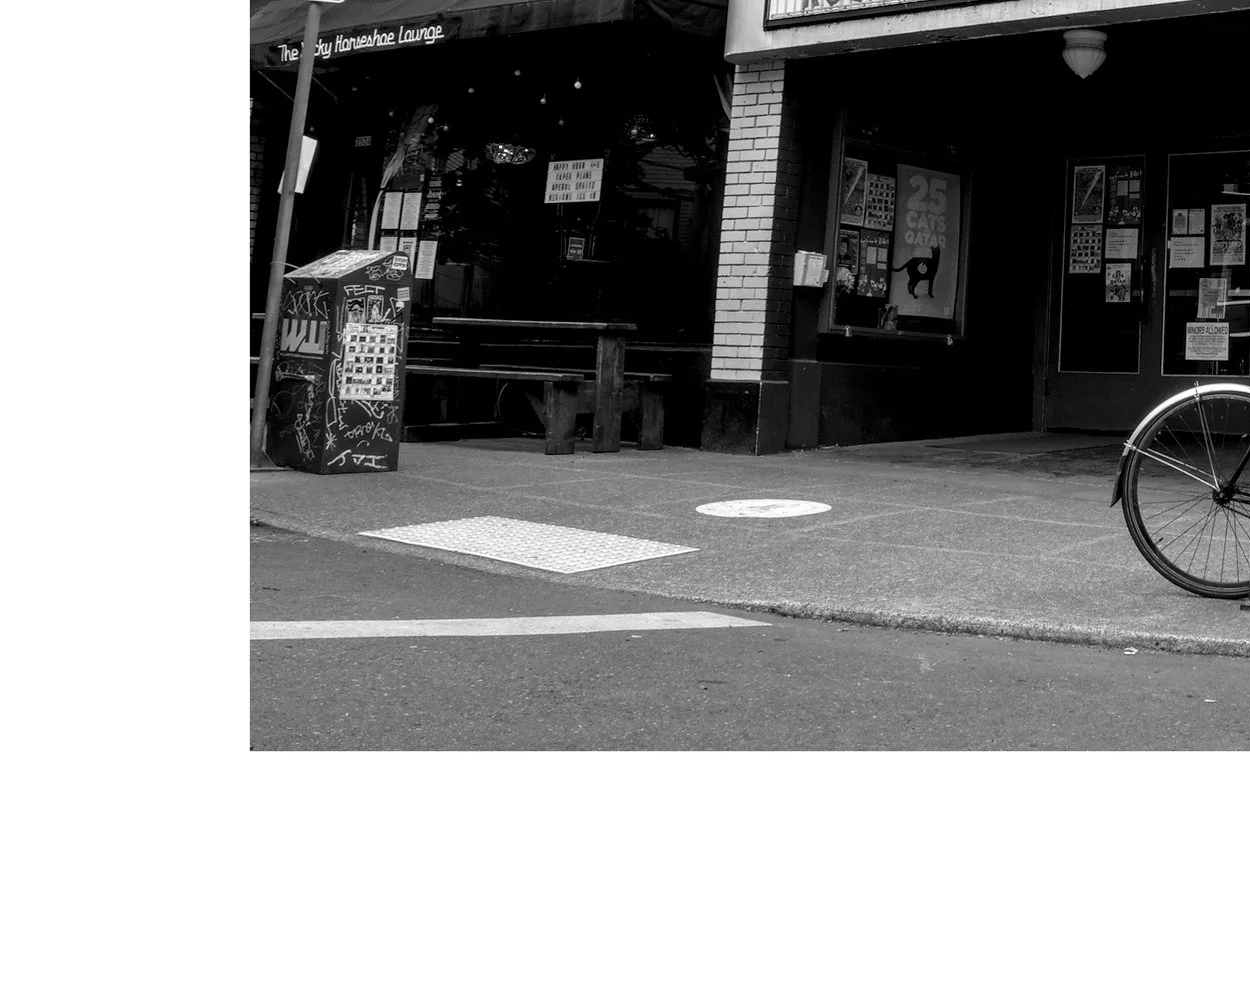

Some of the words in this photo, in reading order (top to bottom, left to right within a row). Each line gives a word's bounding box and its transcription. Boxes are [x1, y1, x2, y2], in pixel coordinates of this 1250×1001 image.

[277, 44, 299, 61] The
[334, 29, 396, 53] Horseshoe
[398, 24, 444, 45] Lounge
[908, 175, 947, 214] 25
[906, 211, 947, 233] CATS
[904, 230, 946, 249] QATAR
[1188, 326, 1205, 335] MINORS
[1206, 326, 1228, 335] ALLOWED
